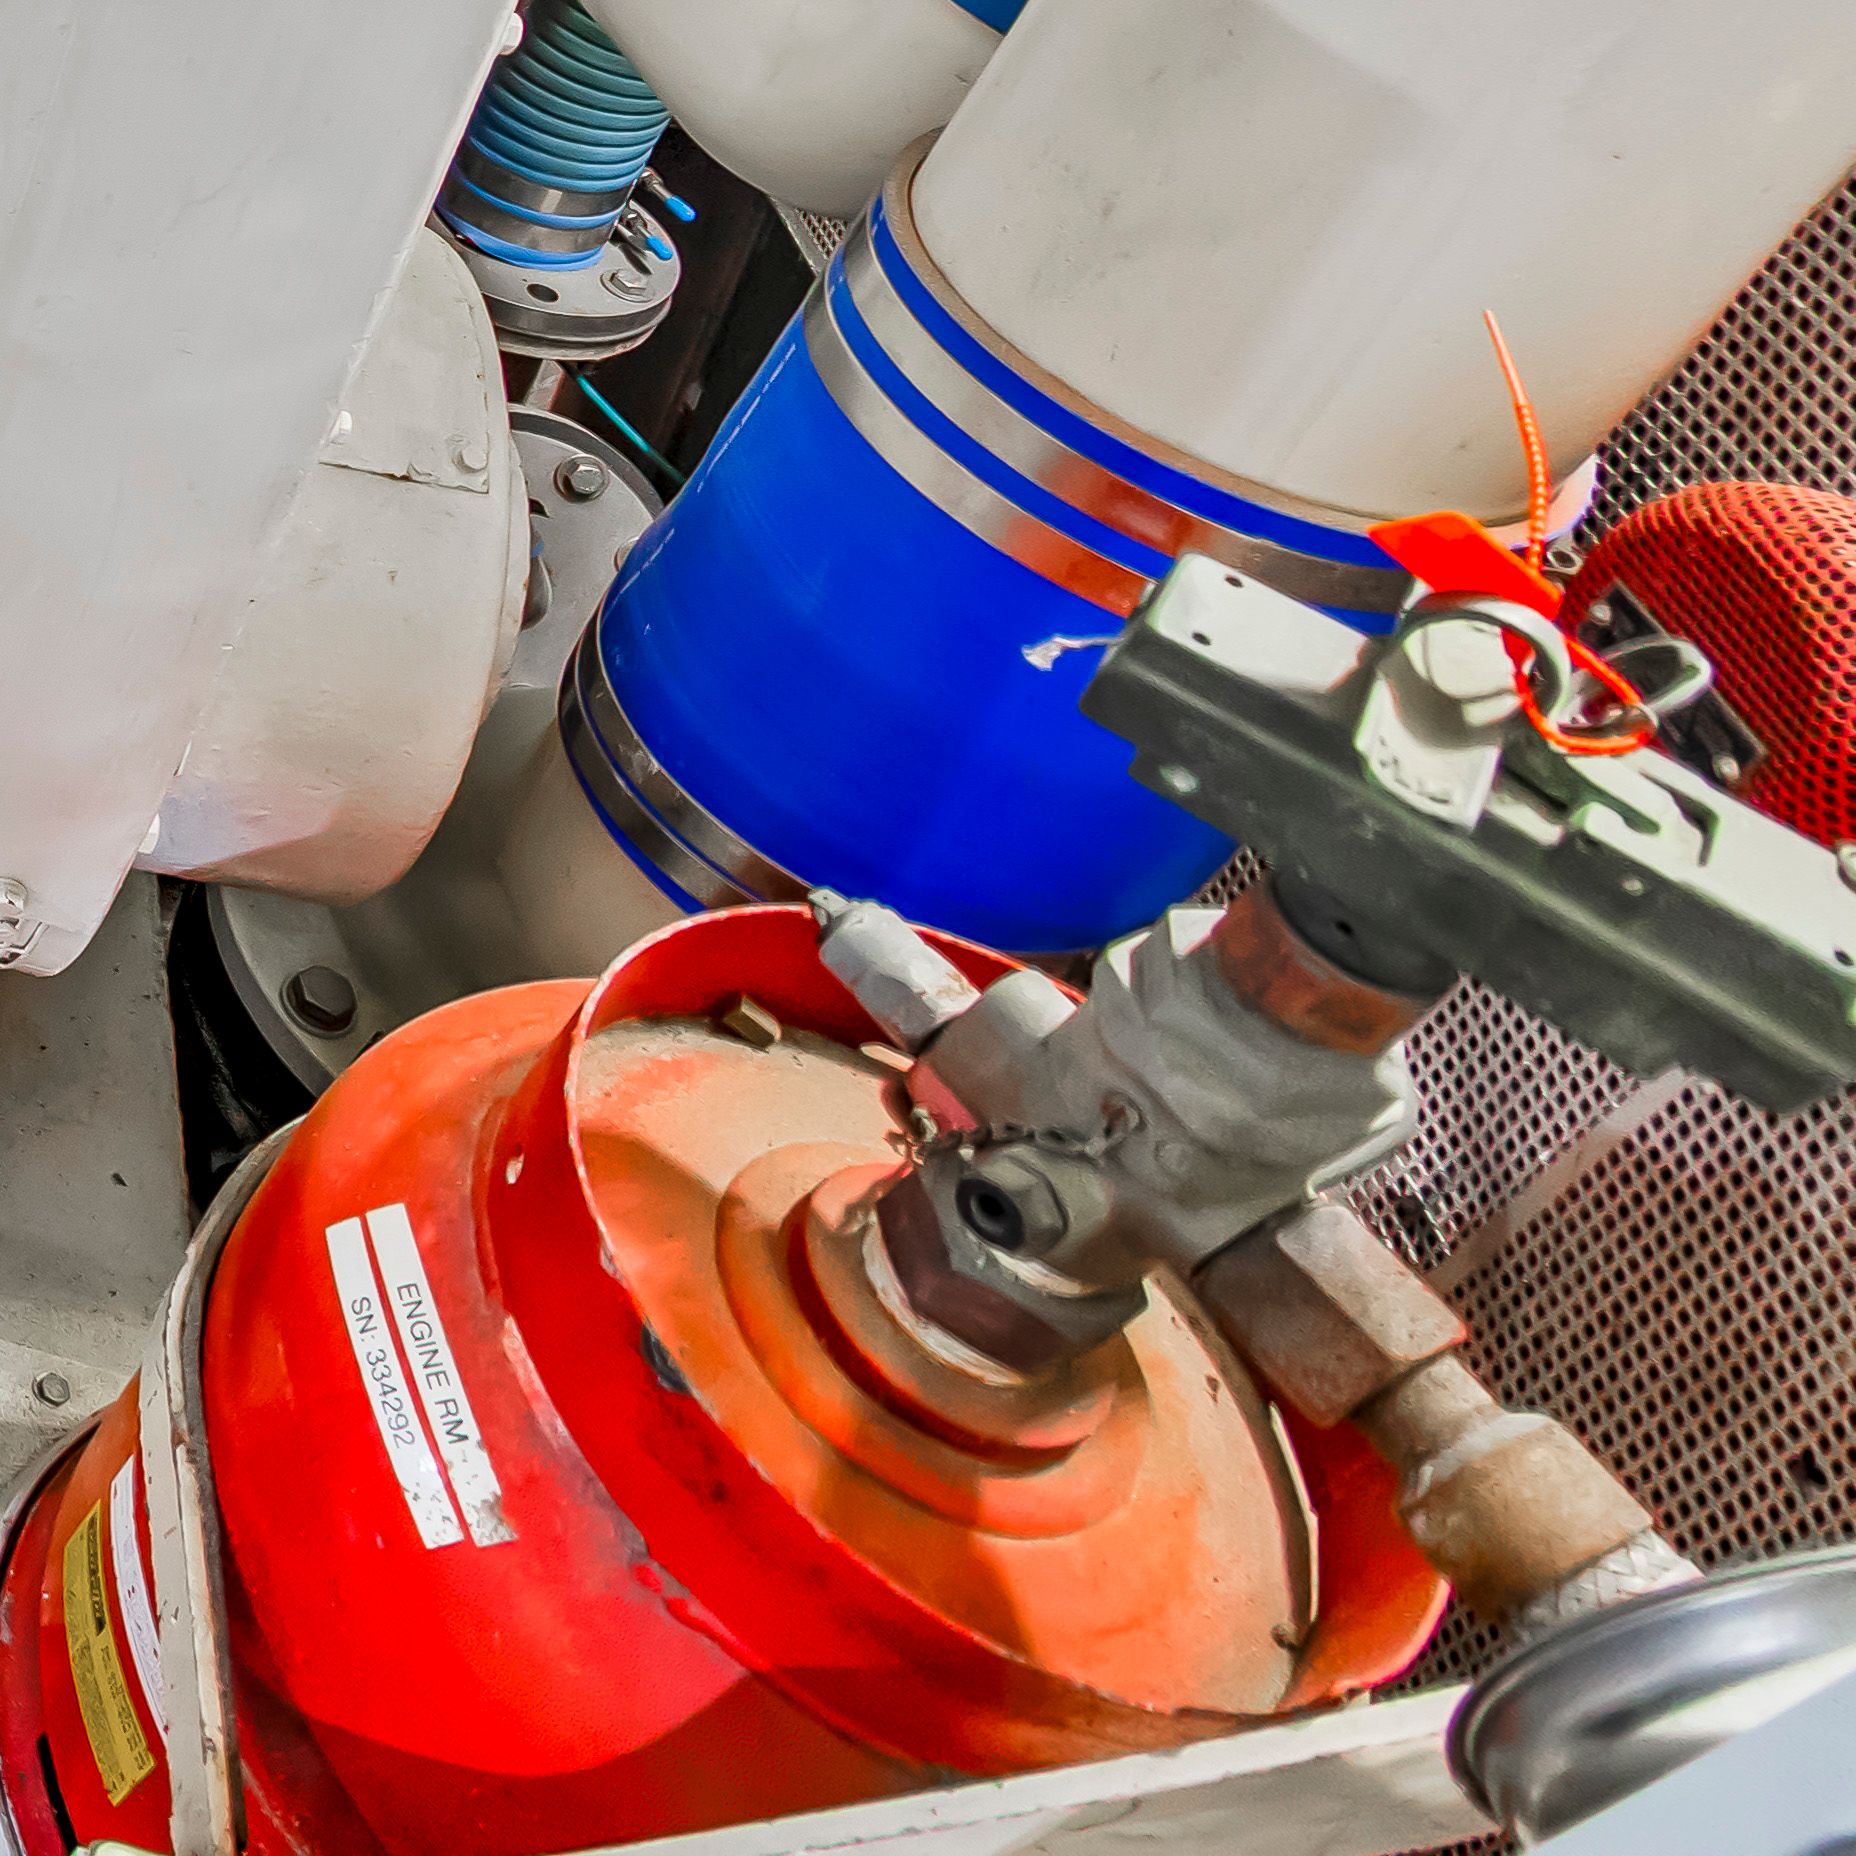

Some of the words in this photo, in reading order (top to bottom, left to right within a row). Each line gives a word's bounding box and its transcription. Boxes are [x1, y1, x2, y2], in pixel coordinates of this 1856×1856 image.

[350, 1296, 378, 1343] SN:
[365, 1347, 417, 1449] 334292
[396, 1282, 451, 1391] ENGINE
[434, 1398, 470, 1445] RM
